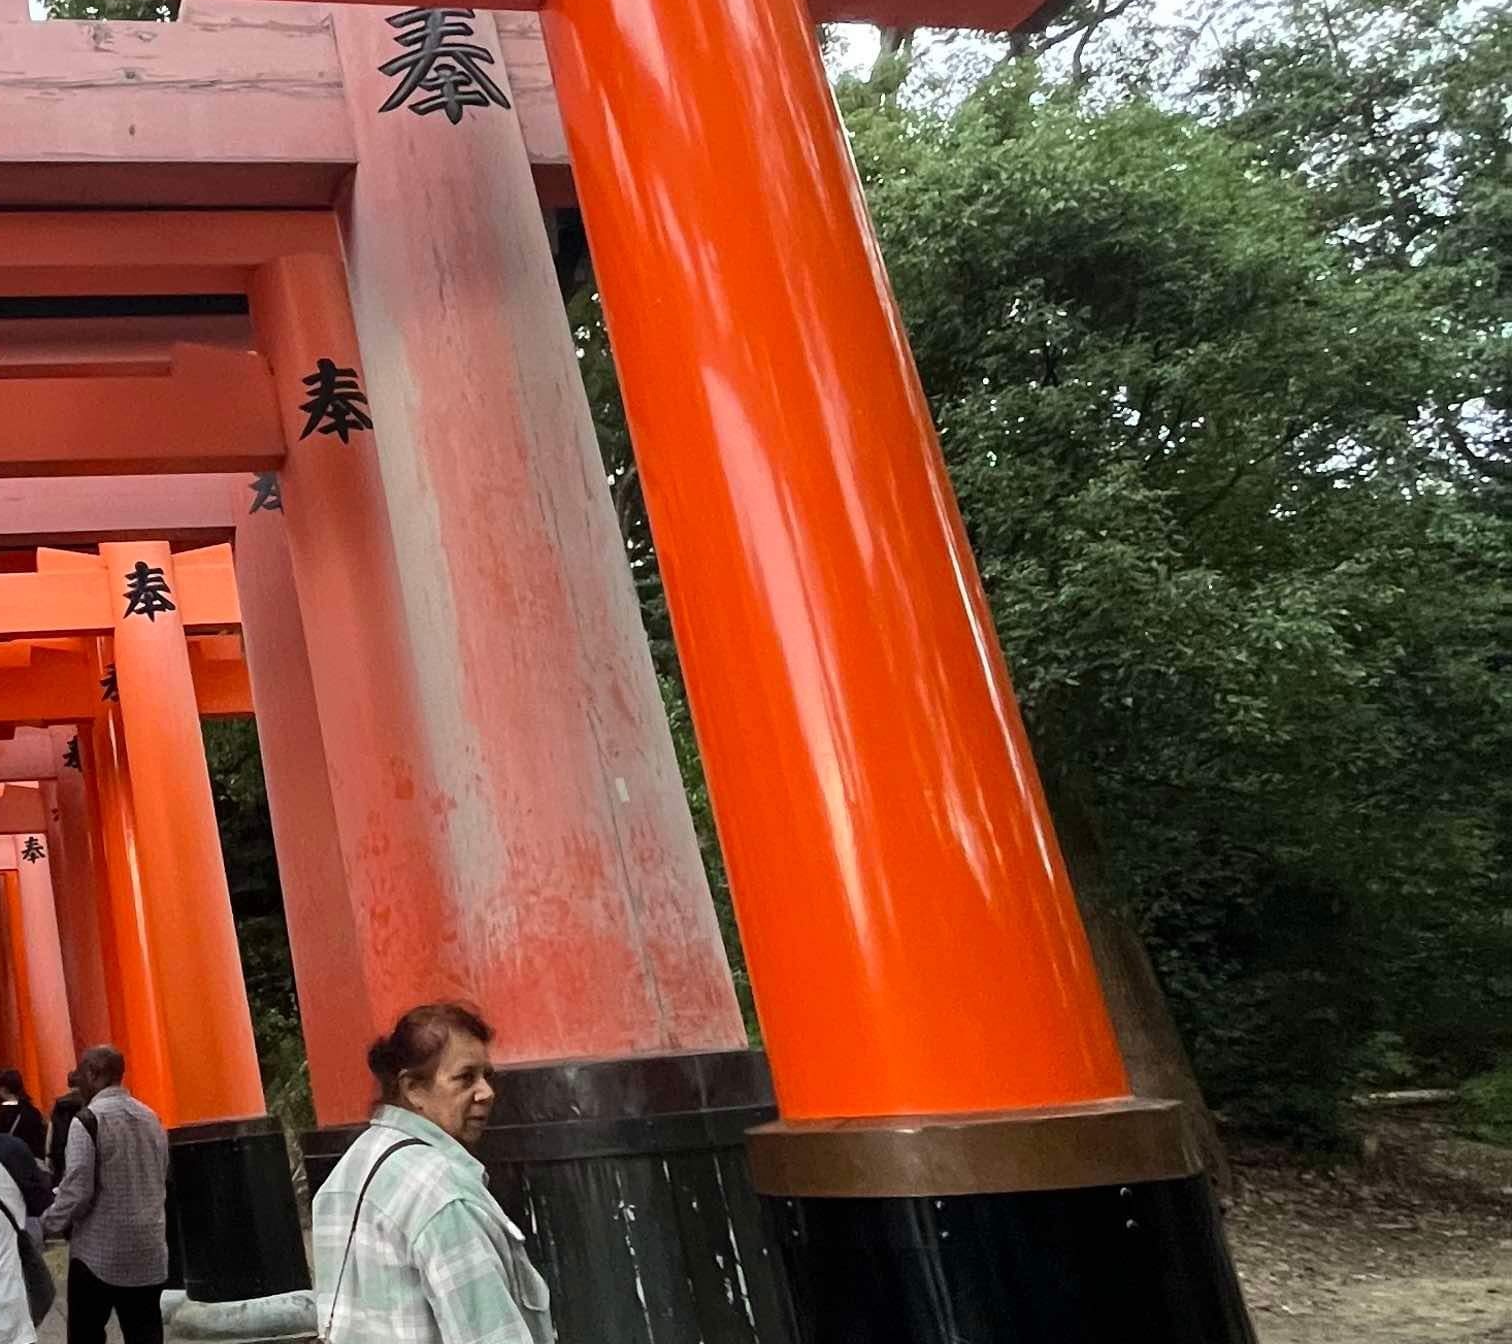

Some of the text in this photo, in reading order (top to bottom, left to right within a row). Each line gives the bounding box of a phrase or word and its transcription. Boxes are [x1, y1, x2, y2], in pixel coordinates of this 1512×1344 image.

[377, 6, 511, 125] 奉
[298, 358, 374, 444] 奉
[123, 561, 176, 622] 奉
[21, 836, 46, 864] 奉
